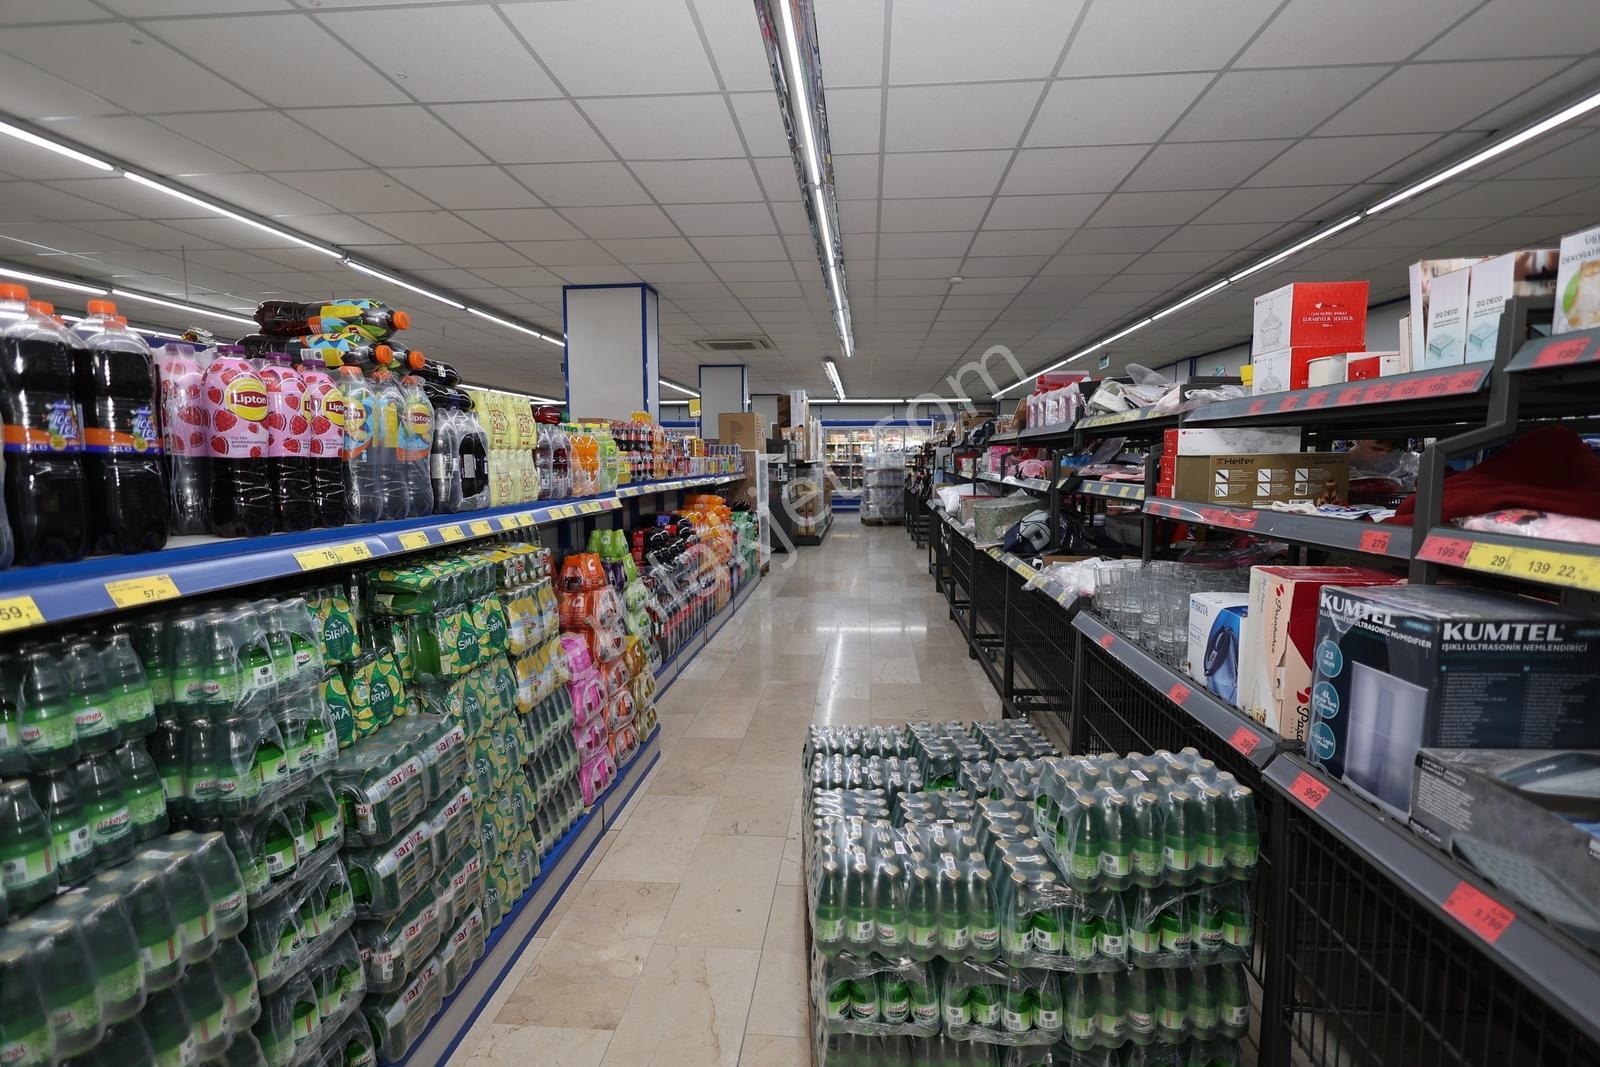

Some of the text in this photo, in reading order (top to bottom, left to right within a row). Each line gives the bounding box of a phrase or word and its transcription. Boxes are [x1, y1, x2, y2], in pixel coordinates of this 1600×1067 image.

[233, 391, 268, 405] Lipton
[321, 551, 335, 561] 76
[1491, 554, 1506, 567] 29
[1528, 560, 1551, 575] 139
[1321, 591, 1397, 629] KUMTEL
[1442, 622, 1564, 642] KUMTEL
[1391, 631, 1432, 649] HUMIDIFIER
[1466, 642, 1522, 651] ULTRASONİK
[1522, 641, 1588, 653] NEMLENDİRİCİ
[1325, 650, 1334, 660] 23
[1304, 787, 1322, 803] 999
